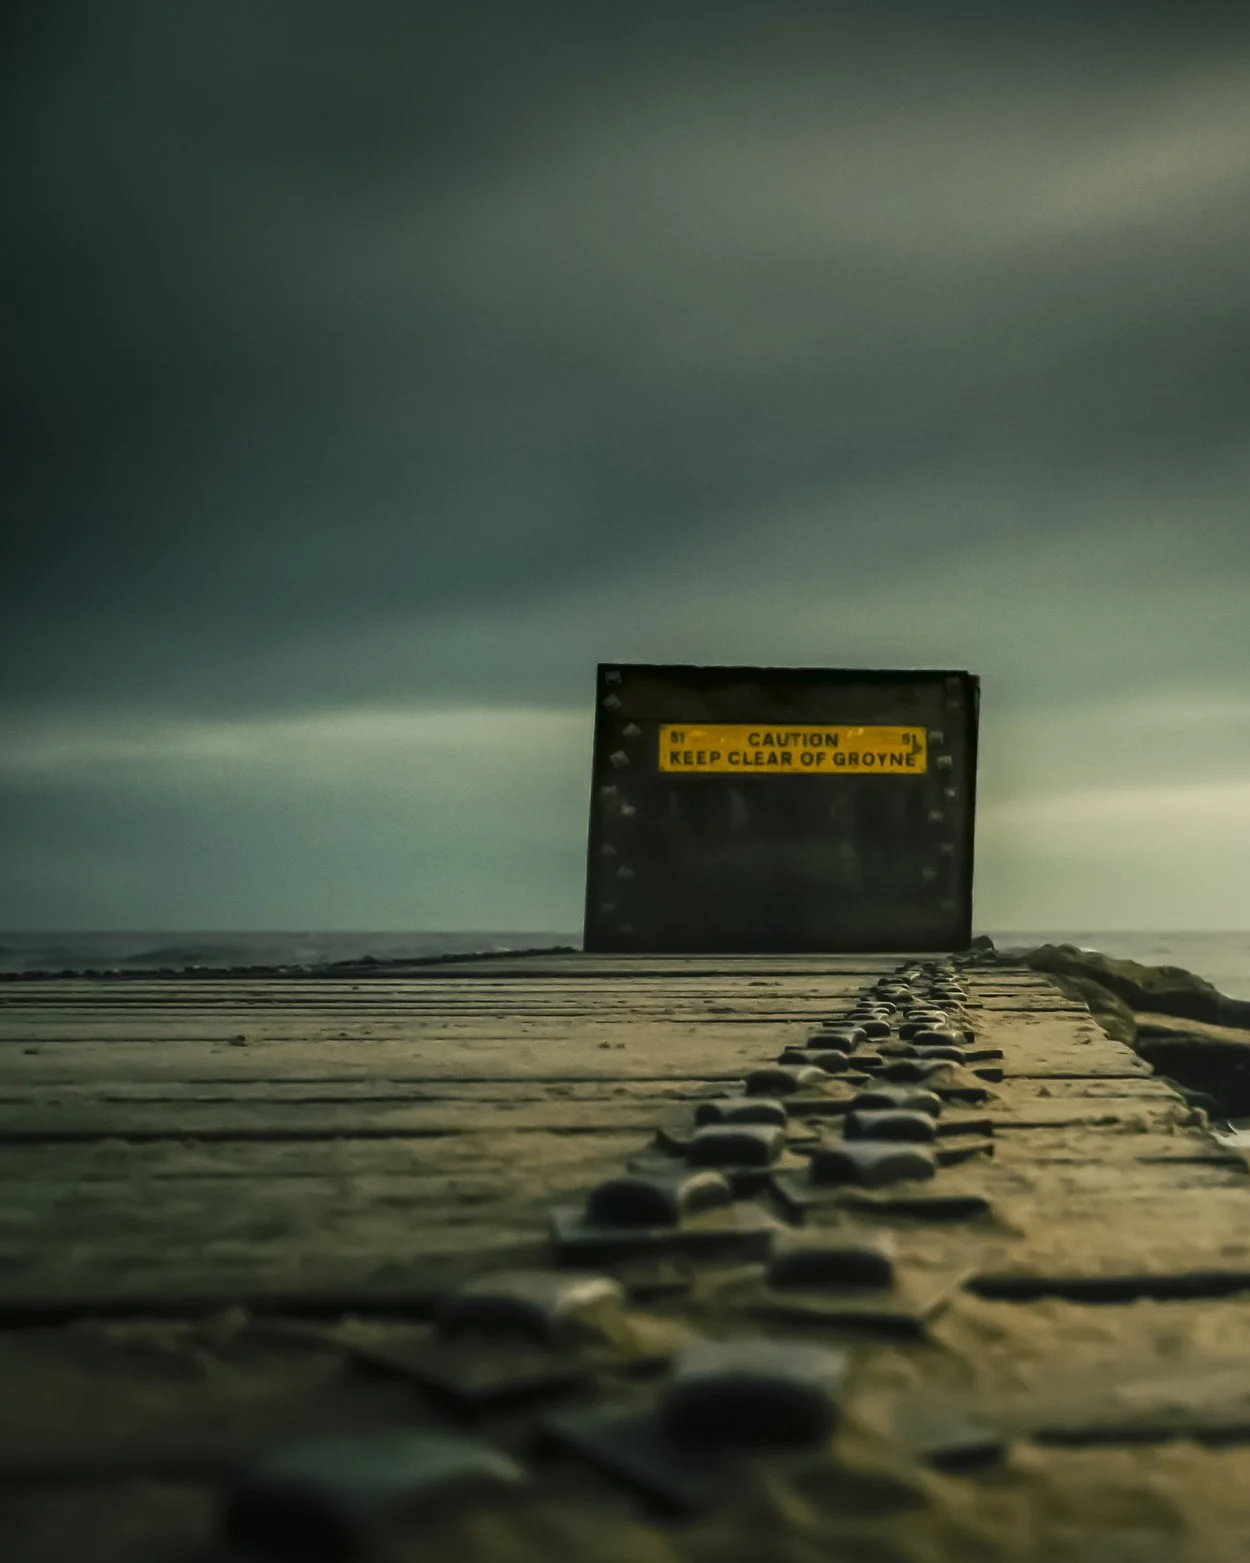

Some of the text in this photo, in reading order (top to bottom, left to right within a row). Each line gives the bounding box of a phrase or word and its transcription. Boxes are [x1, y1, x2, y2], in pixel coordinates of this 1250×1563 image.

[748, 732, 839, 747] CAUTION
[670, 752, 916, 767] KEEP CLEAR OF GROYNE
